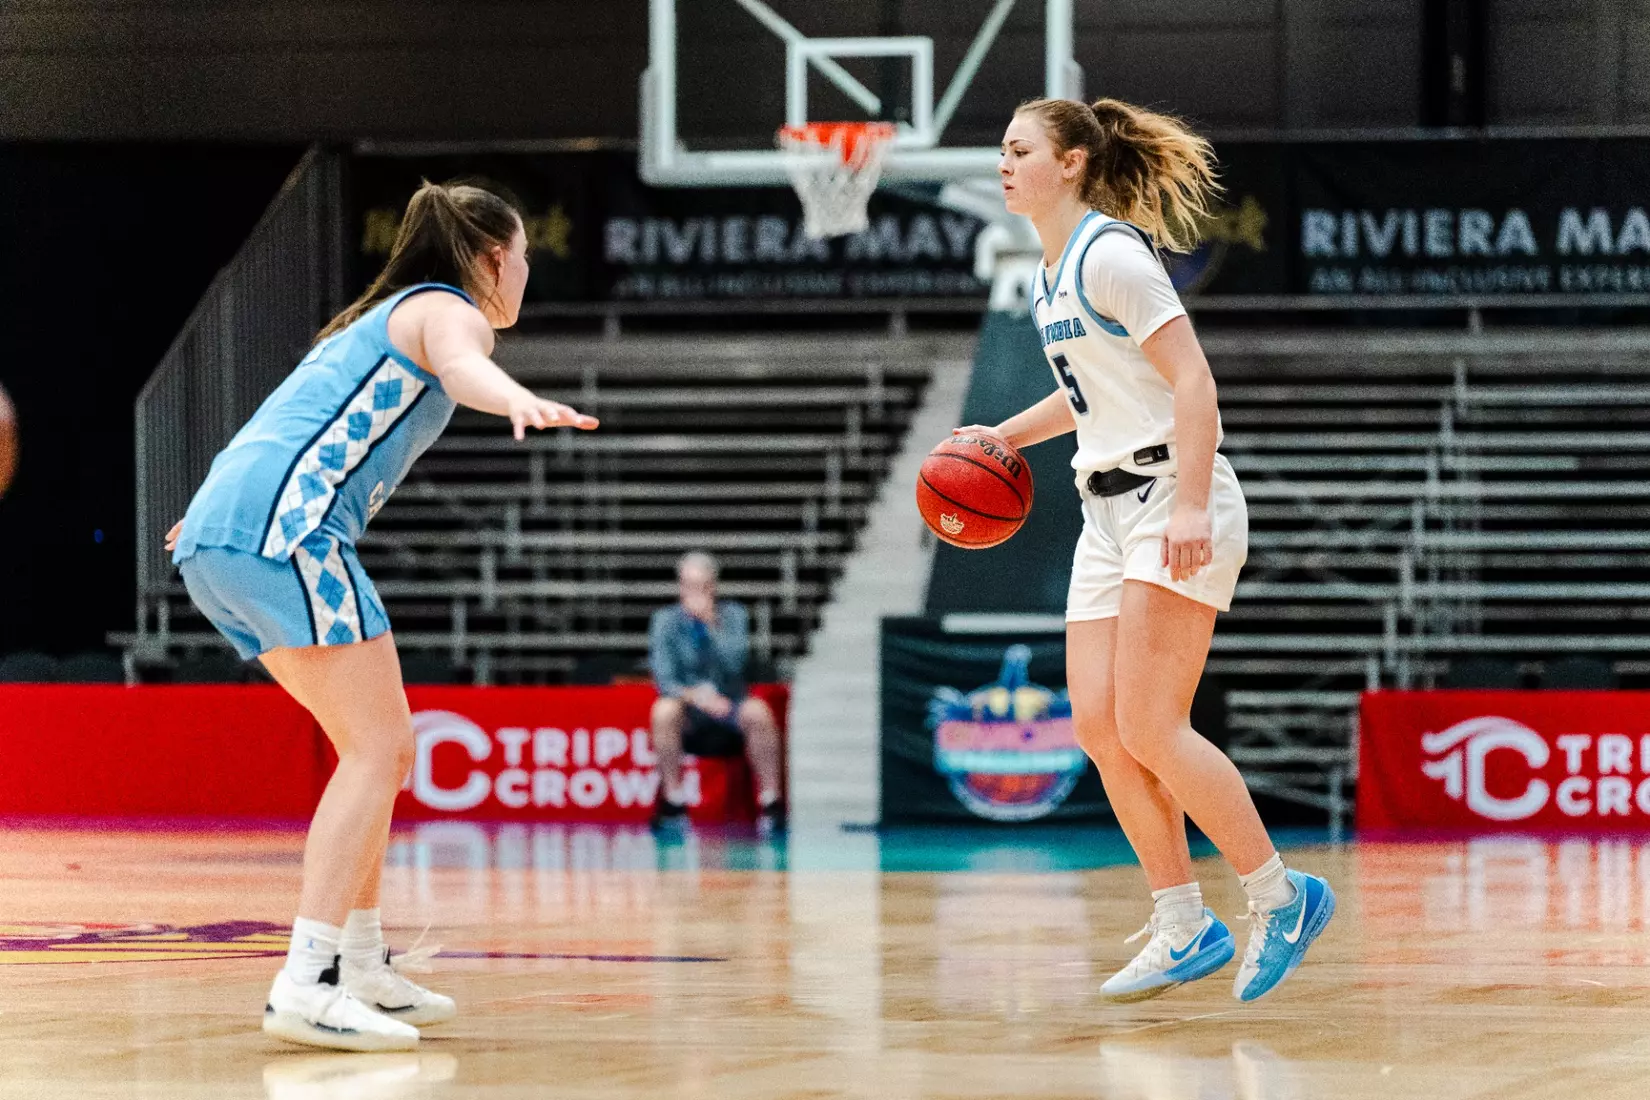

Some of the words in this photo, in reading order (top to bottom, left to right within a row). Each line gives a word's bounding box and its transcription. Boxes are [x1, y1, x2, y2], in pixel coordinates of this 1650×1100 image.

[606, 215, 831, 263] RIVIERA
[1301, 207, 1539, 257] RIVIERA
[1554, 206, 1650, 257] MA
[1051, 353, 1089, 416] 5
[496, 727, 697, 767] TRIPL
